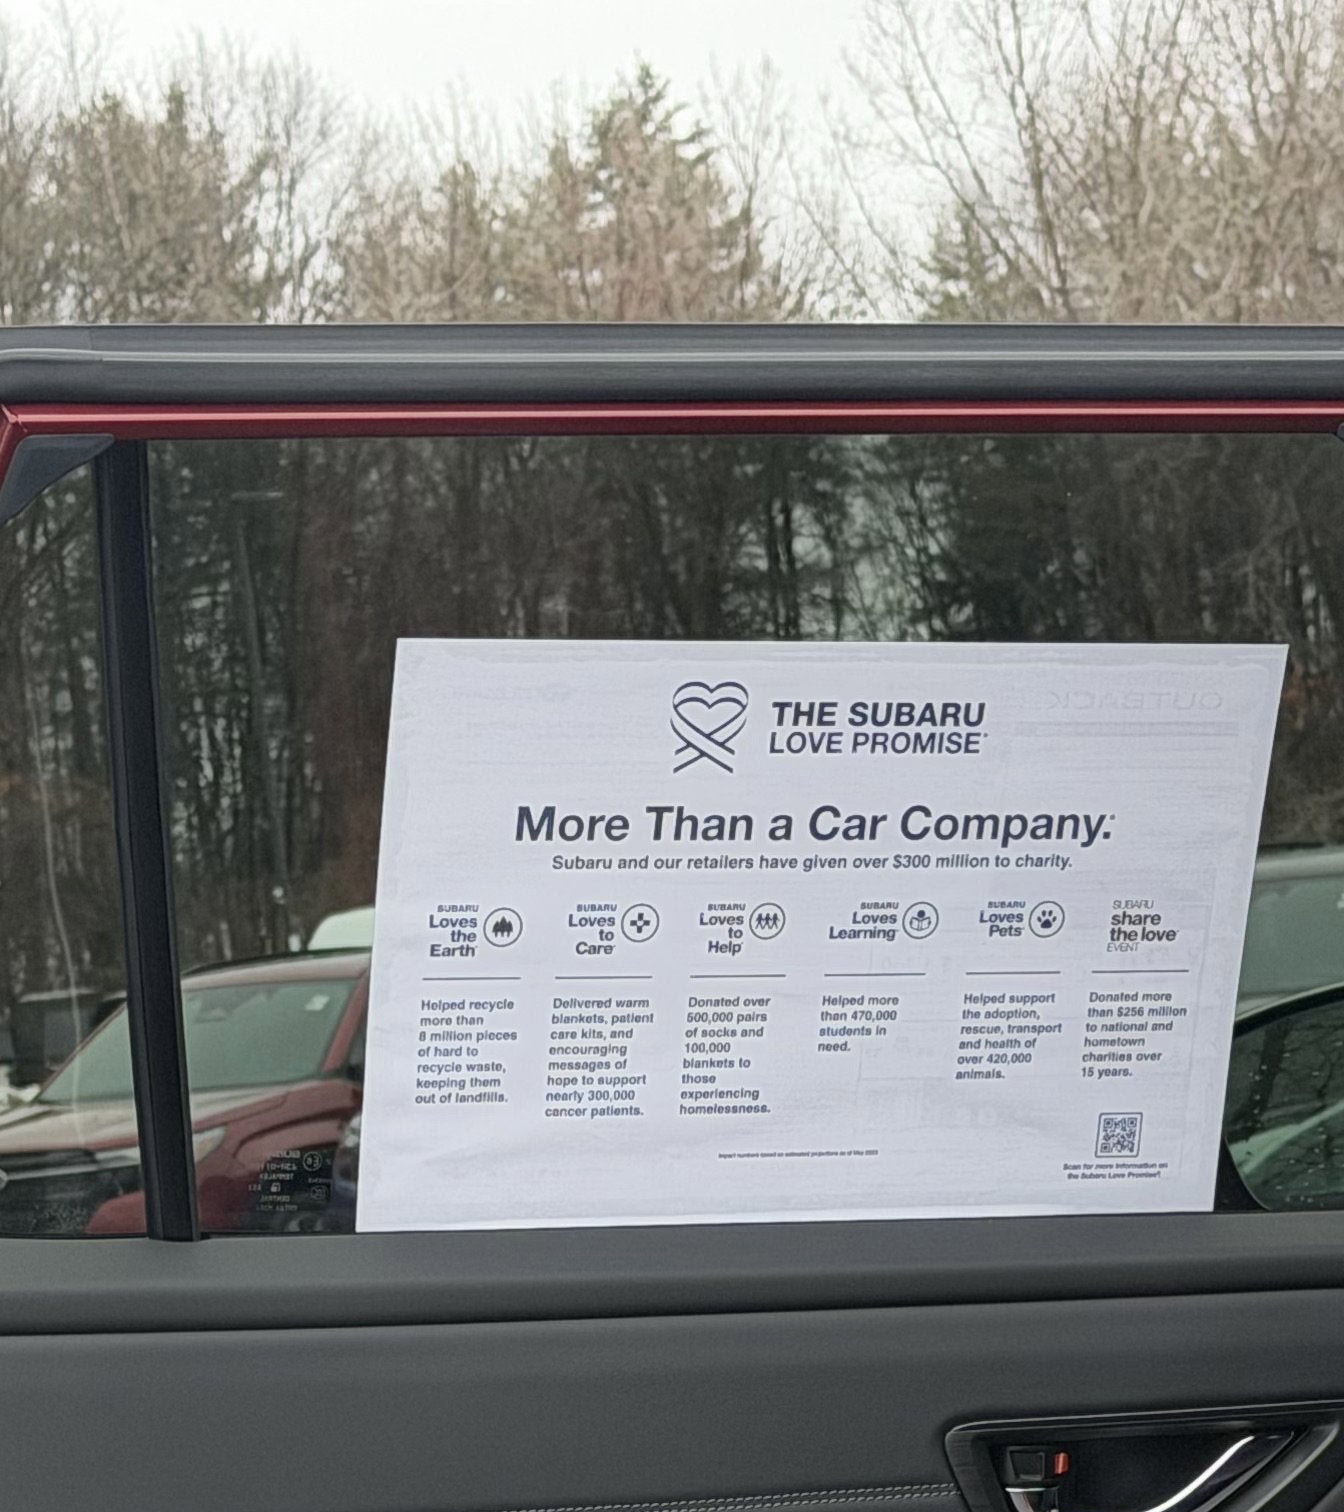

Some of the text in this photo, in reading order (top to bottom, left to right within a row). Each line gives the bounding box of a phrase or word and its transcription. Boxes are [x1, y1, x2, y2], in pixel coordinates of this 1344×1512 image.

[772, 701, 986, 727] THE SUBARU
[769, 731, 984, 754] LOVE PROMISE
[515, 805, 1113, 848] More Than a Car Company.
[552, 853, 1072, 873] Subaru and our retailers have given over $300 million to charity.
[437, 904, 479, 913] SUBARU
[576, 904, 617, 912] SUBARU
[707, 903, 746, 912] SUBARU
[860, 902, 900, 910] SUBARU
[987, 900, 1026, 909] SUBARU
[1112, 899, 1154, 910] SUBARU
[429, 914, 478, 929] Loves
[568, 913, 616, 927] Loves
[699, 912, 744, 926] Loves
[852, 911, 898, 925] Loves
[979, 910, 1024, 924] Loves
[1111, 910, 1162, 926] share
[450, 929, 477, 943] the
[598, 929, 615, 942] to
[728, 927, 743, 939] to
[829, 926, 897, 942] Learning
[989, 924, 1023, 937] Pets
[1110, 925, 1177, 942] the love
[429, 944, 476, 957] Earth
[575, 941, 614, 955] Care
[708, 940, 741, 957] Help
[1106, 941, 1140, 953] EVENT
[553, 997, 649, 1009] Delivered warm
[688, 996, 771, 1008] Donated over
[822, 995, 899, 1008] Helped more
[963, 992, 1056, 1007] Helped support
[1089, 991, 1172, 1003] Donated more
[421, 998, 514, 1013] Helped recycle
[1087, 1006, 1187, 1018] than $256 million
[420, 1015, 484, 1027] more than
[551, 1012, 654, 1026] blankets, patient
[687, 1011, 767, 1025] 500,000 pairs
[820, 1010, 898, 1023] than 470,000
[962, 1007, 1040, 1022] the adoption,
[685, 1026, 764, 1038] of socks and
[819, 1025, 887, 1037] students in
[960, 1023, 1062, 1036] rescue, transport
[1085, 1020, 1173, 1033] to national and
[418, 1030, 517, 1044] 8 million pieces
[550, 1028, 634, 1041] care kits, and
[818, 1040, 851, 1052] need.
[958, 1037, 1037, 1050] and health of
[1083, 1036, 1145, 1047] hometown
[417, 1045, 479, 1057] of hard to
[549, 1043, 628, 1057] encouraging
[685, 1042, 731, 1055] 100,000
[683, 1057, 751, 1069] blankets to
[957, 1052, 1032, 1065] over 420,000
[1082, 1051, 1163, 1063] charities over
[417, 1061, 506, 1076] recycle waste,
[548, 1058, 628, 1073] messages of
[681, 1073, 717, 1084] those
[955, 1068, 1005, 1080] animals.
[1081, 1066, 1133, 1080] 15 years.
[416, 1077, 501, 1091] keeping them
[547, 1074, 647, 1088] hope to support
[415, 1091, 508, 1104] out of landfills.
[545, 1089, 635, 1104] nearly 300,000
[680, 1087, 760, 1102] experiencing
[545, 1105, 644, 1120] cancer patients.
[679, 1103, 771, 1115] homelessness.
